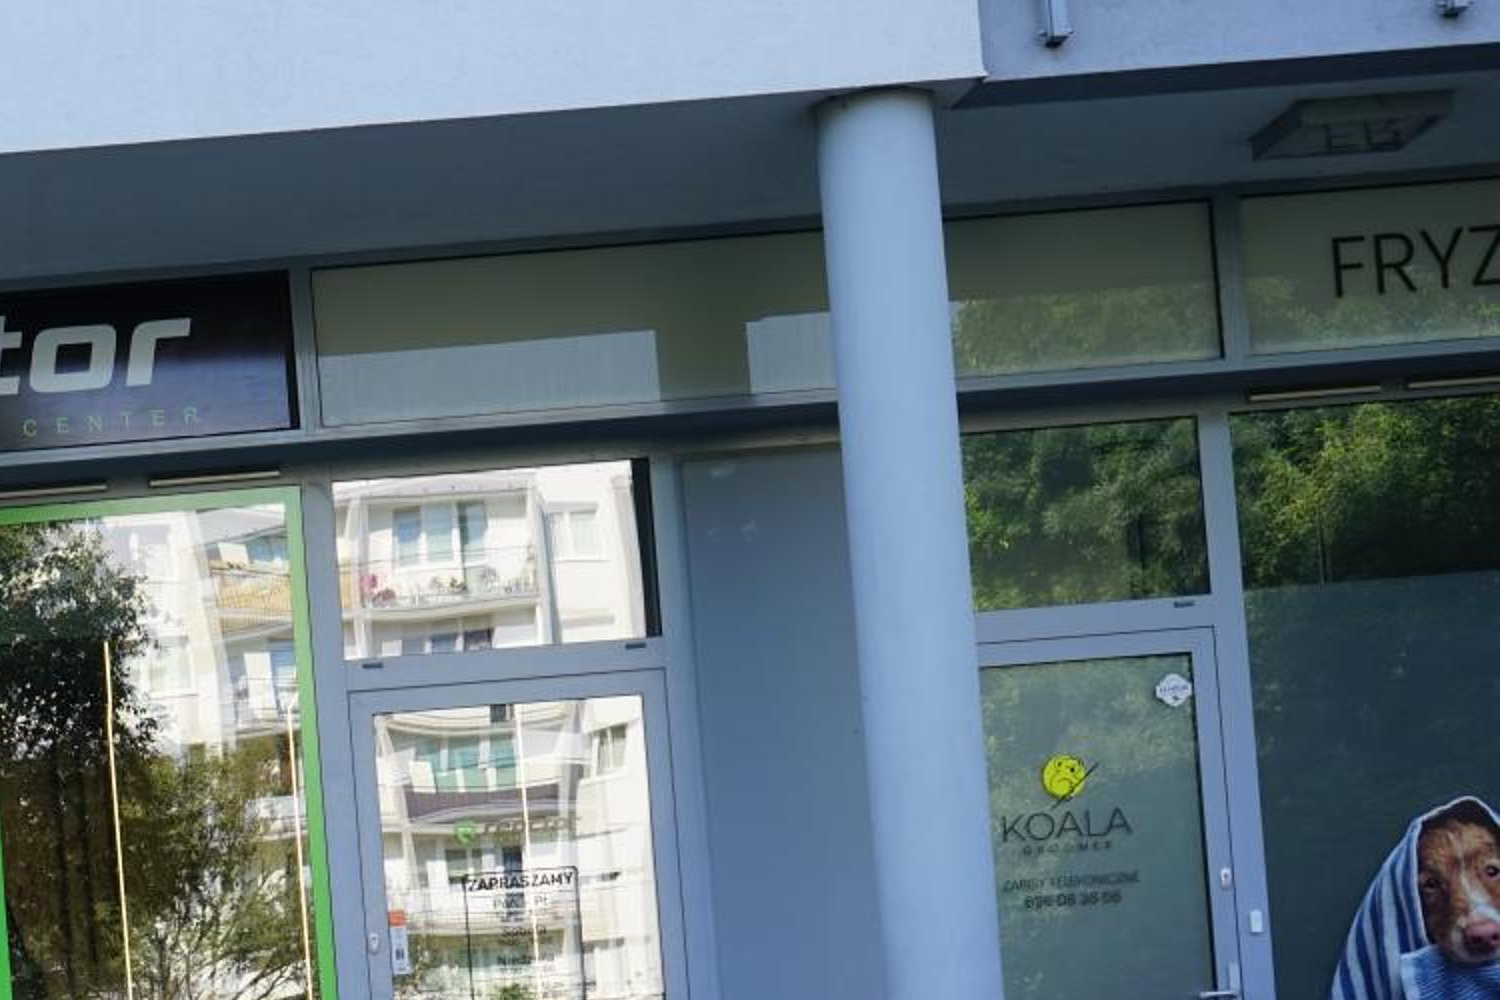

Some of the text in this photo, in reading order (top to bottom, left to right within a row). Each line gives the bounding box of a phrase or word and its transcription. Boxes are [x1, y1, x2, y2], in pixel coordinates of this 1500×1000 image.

[1331, 225, 1500, 298] FRYZ
[23, 406, 199, 437] CENTER
[1001, 806, 1133, 842] KOALA
[468, 871, 574, 892] ZAPRASZAMY
